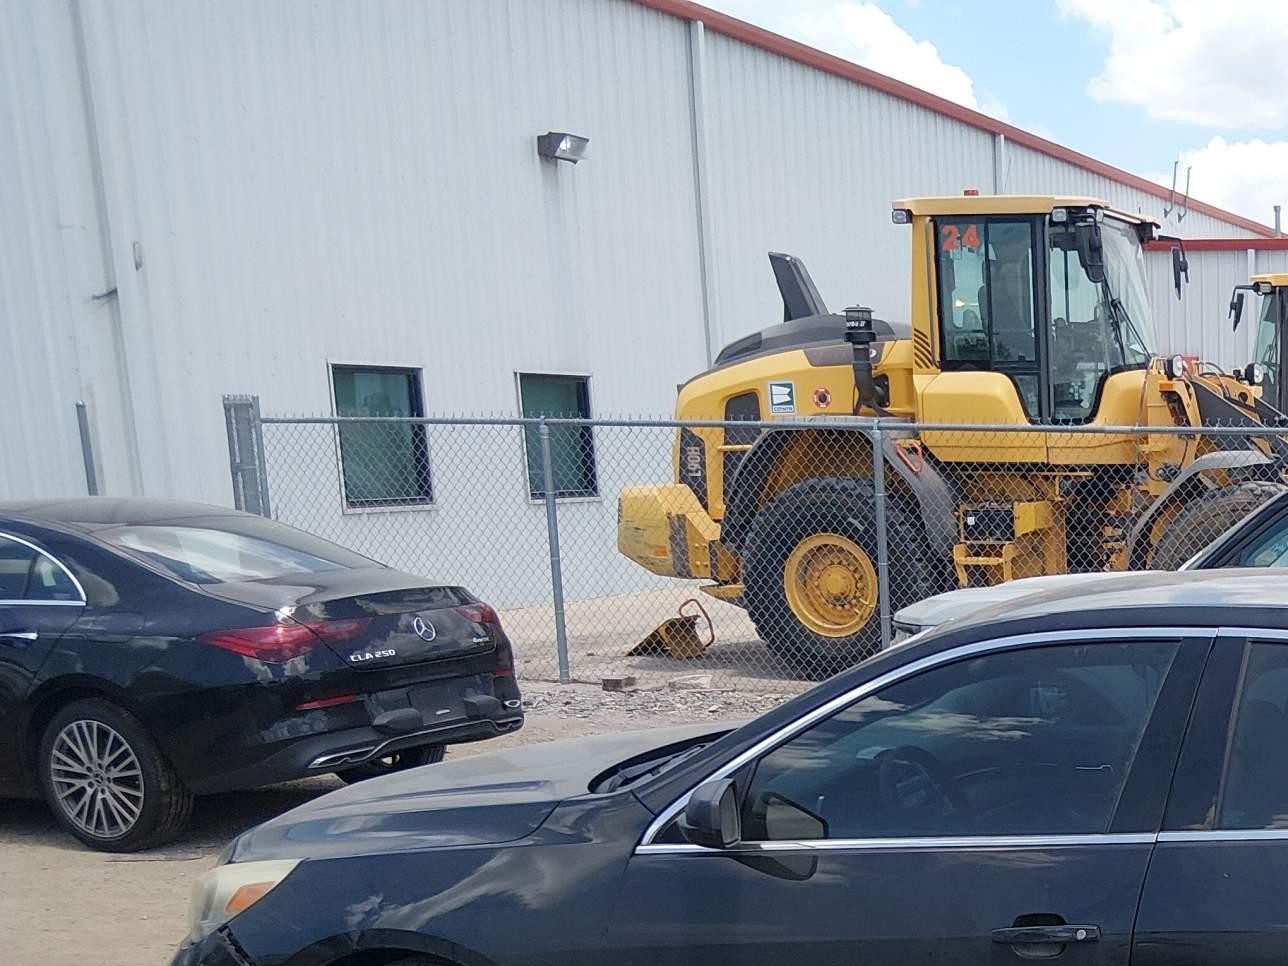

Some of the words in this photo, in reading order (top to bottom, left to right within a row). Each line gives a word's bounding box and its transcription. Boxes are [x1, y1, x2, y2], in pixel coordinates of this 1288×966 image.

[942, 223, 981, 251] 24
[687, 446, 701, 477] L90H
[350, 652, 374, 662] CLA
[375, 649, 396, 658] 250
